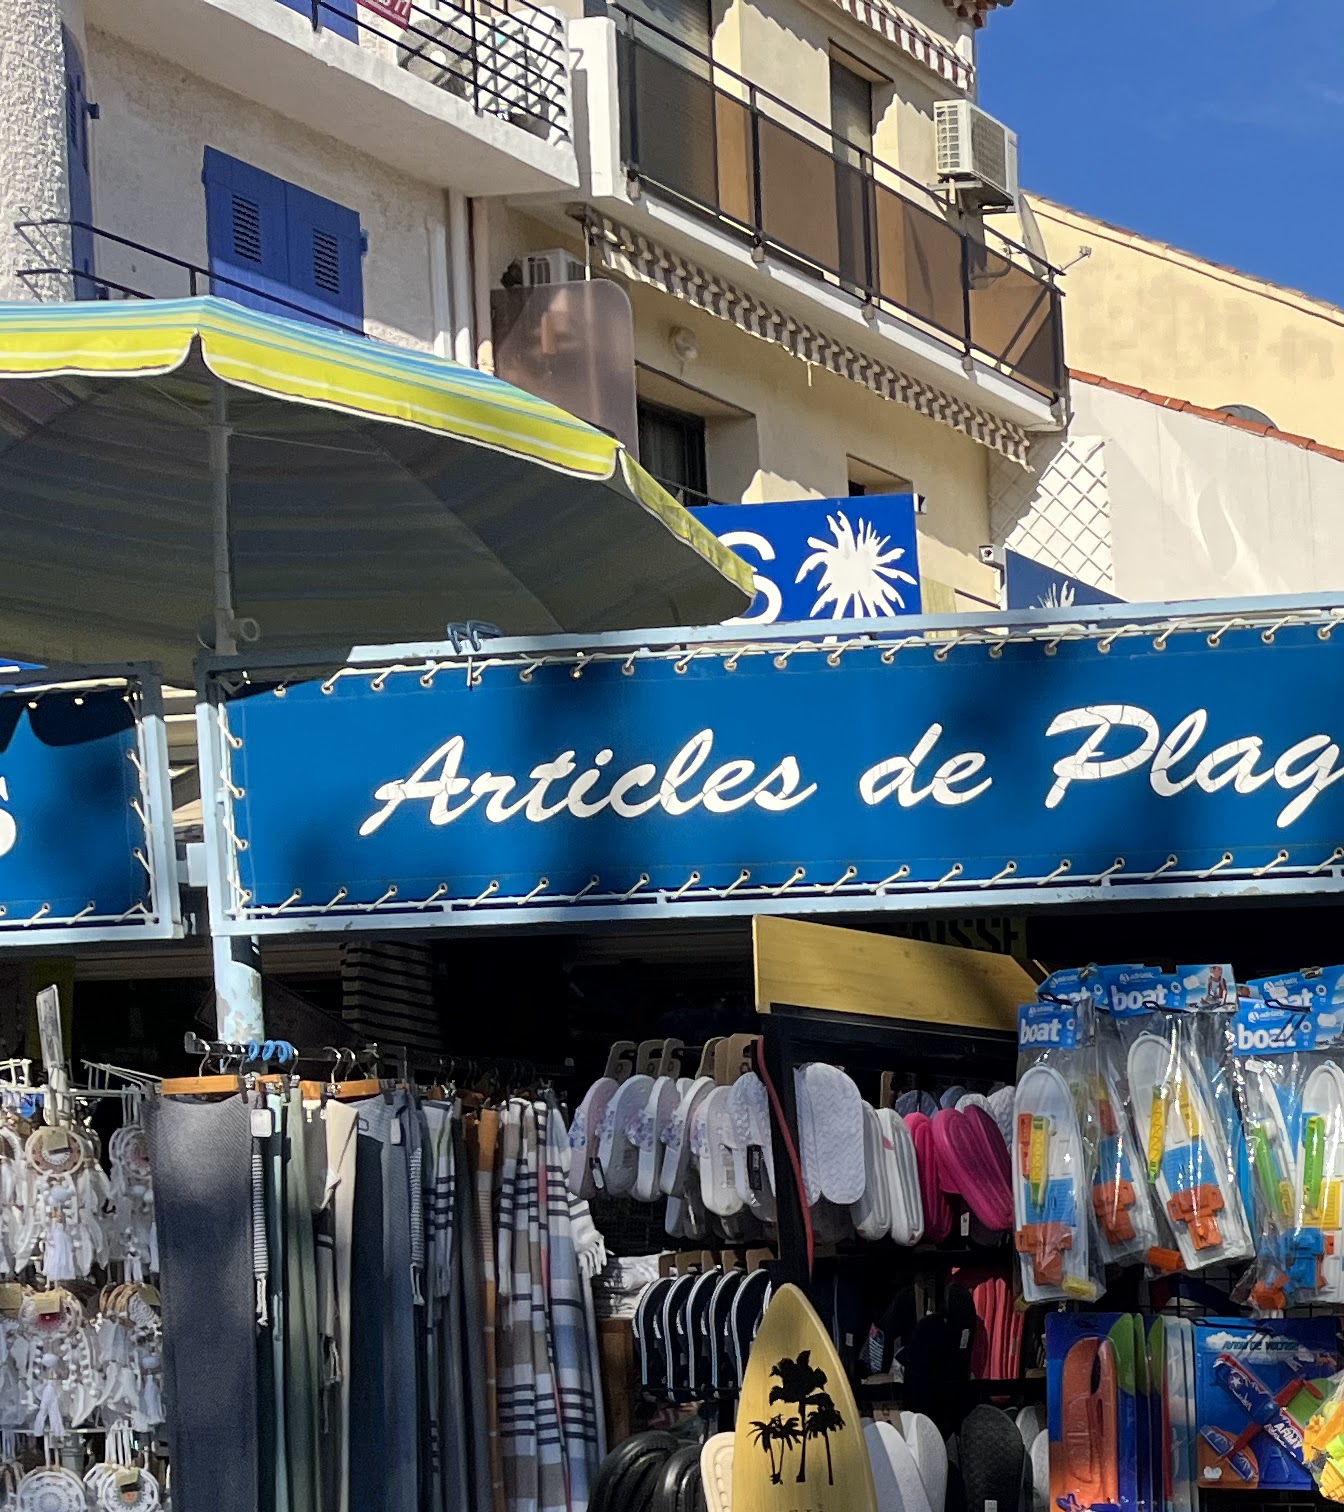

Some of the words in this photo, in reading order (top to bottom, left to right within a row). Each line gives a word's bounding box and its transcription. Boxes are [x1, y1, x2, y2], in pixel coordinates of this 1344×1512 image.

[359, 728, 818, 836] Articles
[859, 723, 993, 808] de
[1111, 983, 1169, 1011] boat
[1018, 1017, 1063, 1044] boat
[1236, 1024, 1296, 1050] boat
